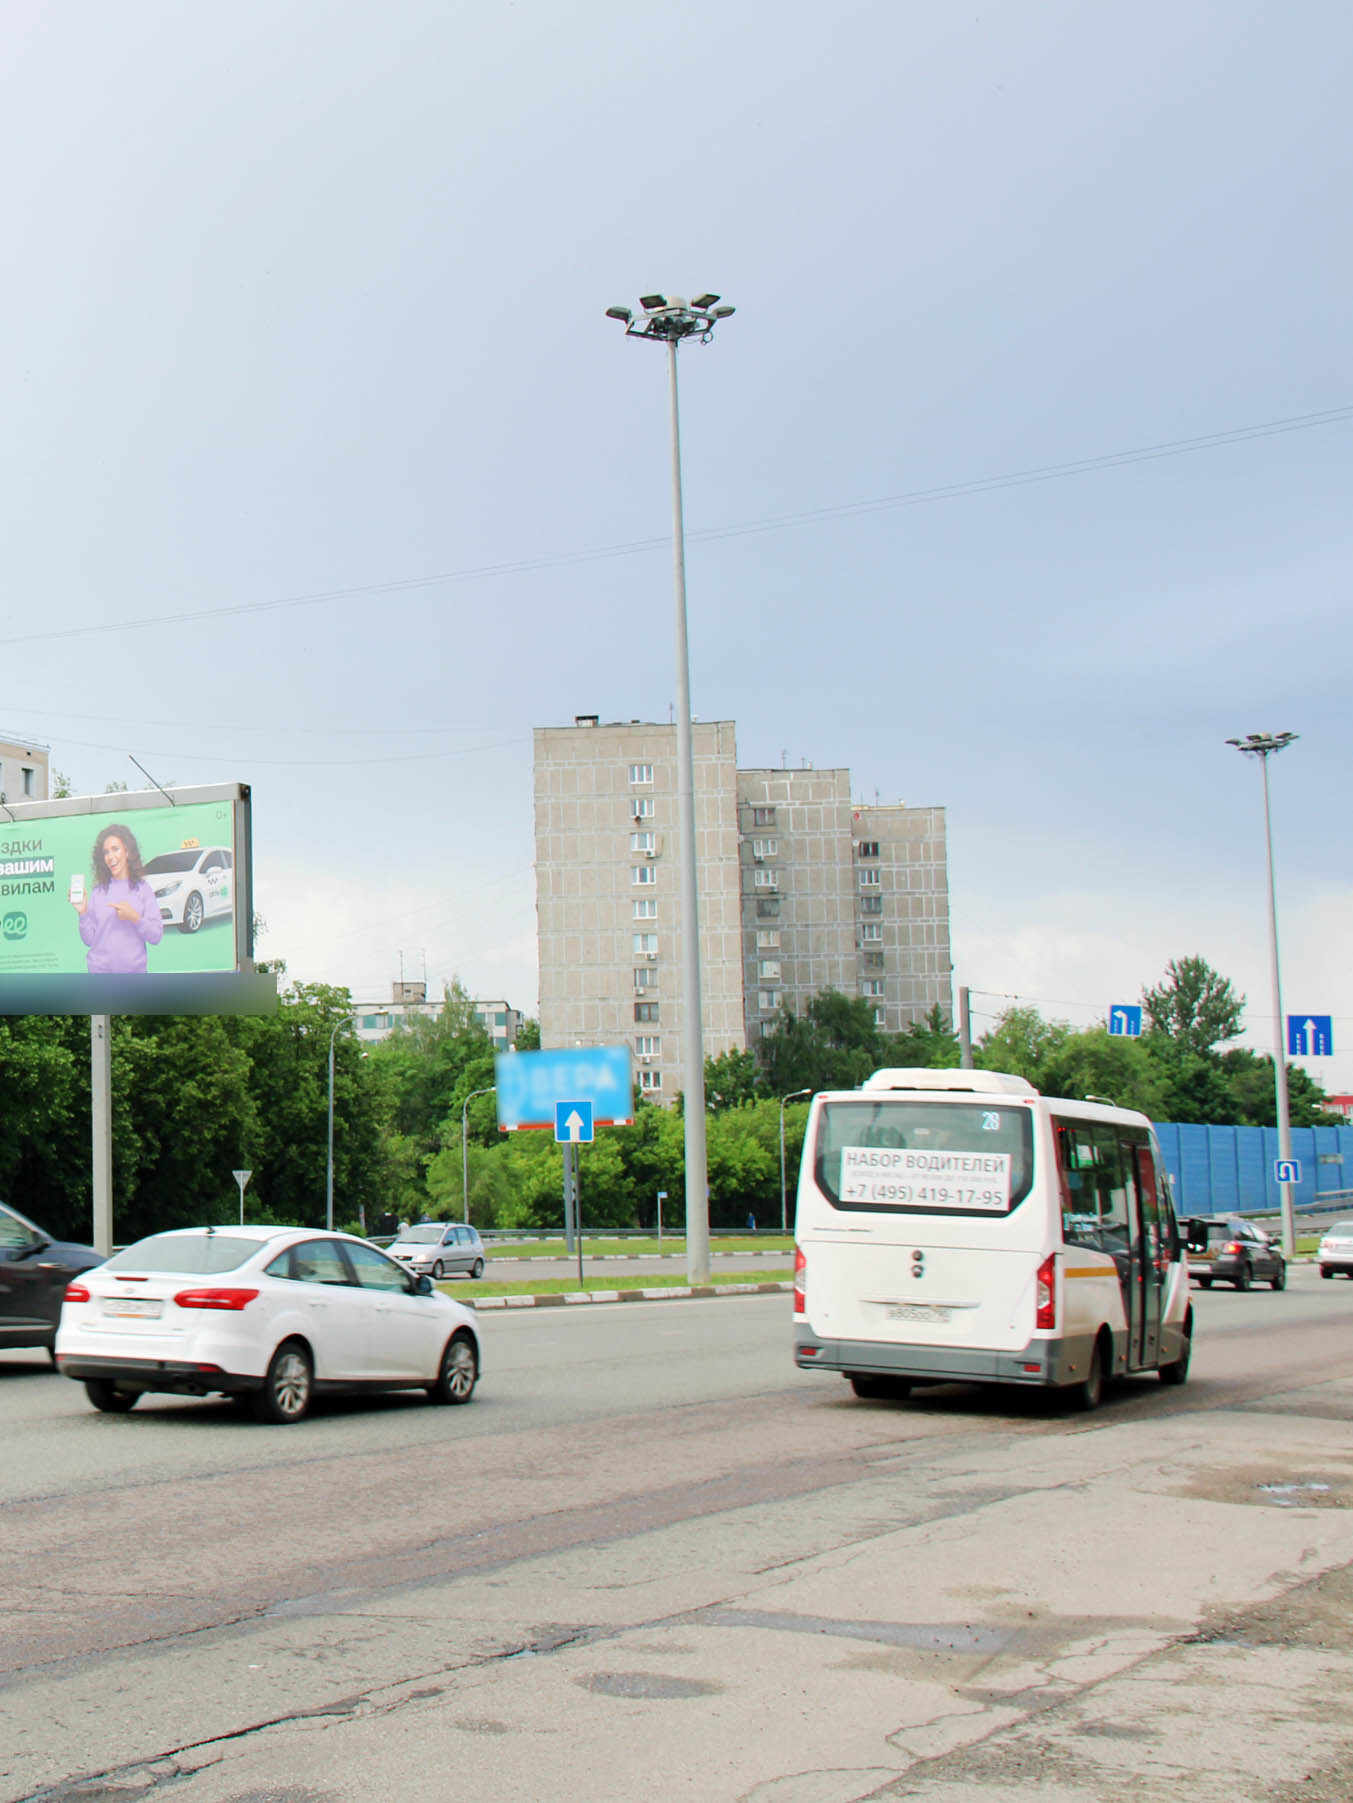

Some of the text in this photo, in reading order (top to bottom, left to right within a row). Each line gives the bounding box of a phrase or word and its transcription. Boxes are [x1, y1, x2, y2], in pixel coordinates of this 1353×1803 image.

[847, 1152, 1005, 1173] НАБОР ВОДИТЕЛЕЙ
[846, 1184, 1003, 1206] +7 (495) 419-17-95
